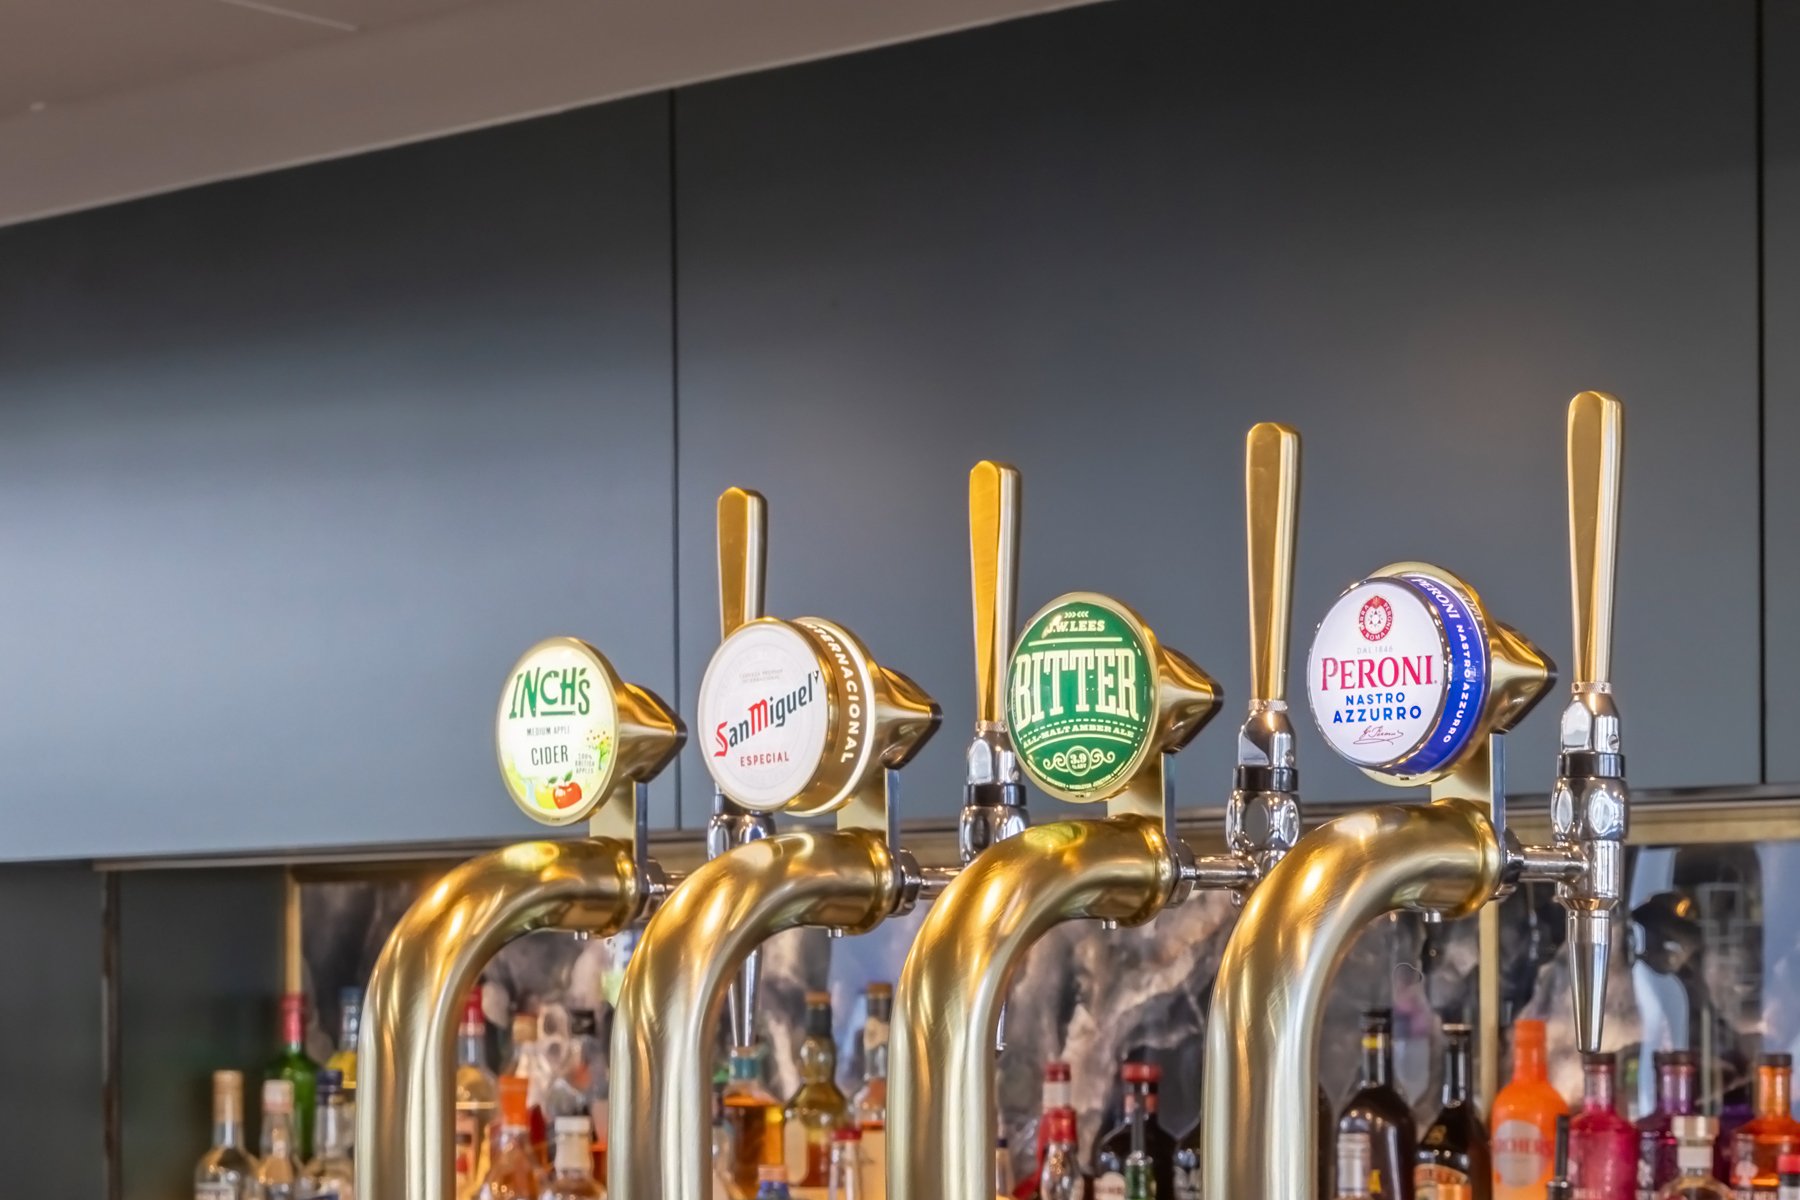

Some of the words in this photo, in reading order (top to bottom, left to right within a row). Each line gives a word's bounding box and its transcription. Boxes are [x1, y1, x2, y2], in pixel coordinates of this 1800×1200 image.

[1411, 578, 1460, 619] PERONI
[1069, 620, 1105, 632] LEES
[1365, 632, 1385, 641] ROMA
[1456, 624, 1471, 679] NASTRO
[1321, 655, 1434, 691] PERONI
[1015, 648, 1139, 732] BITTER
[1346, 692, 1405, 706] NASTRO
[1333, 705, 1422, 724] AZZURRO
[1443, 682, 1470, 743] AZZURRO
[1071, 724, 1112, 734] AMBER
[1112, 727, 1135, 738] ALE
[530, 744, 569, 766] CIDER
[740, 751, 790, 767] ESPECIAL
[1069, 753, 1087, 764] 3.9
